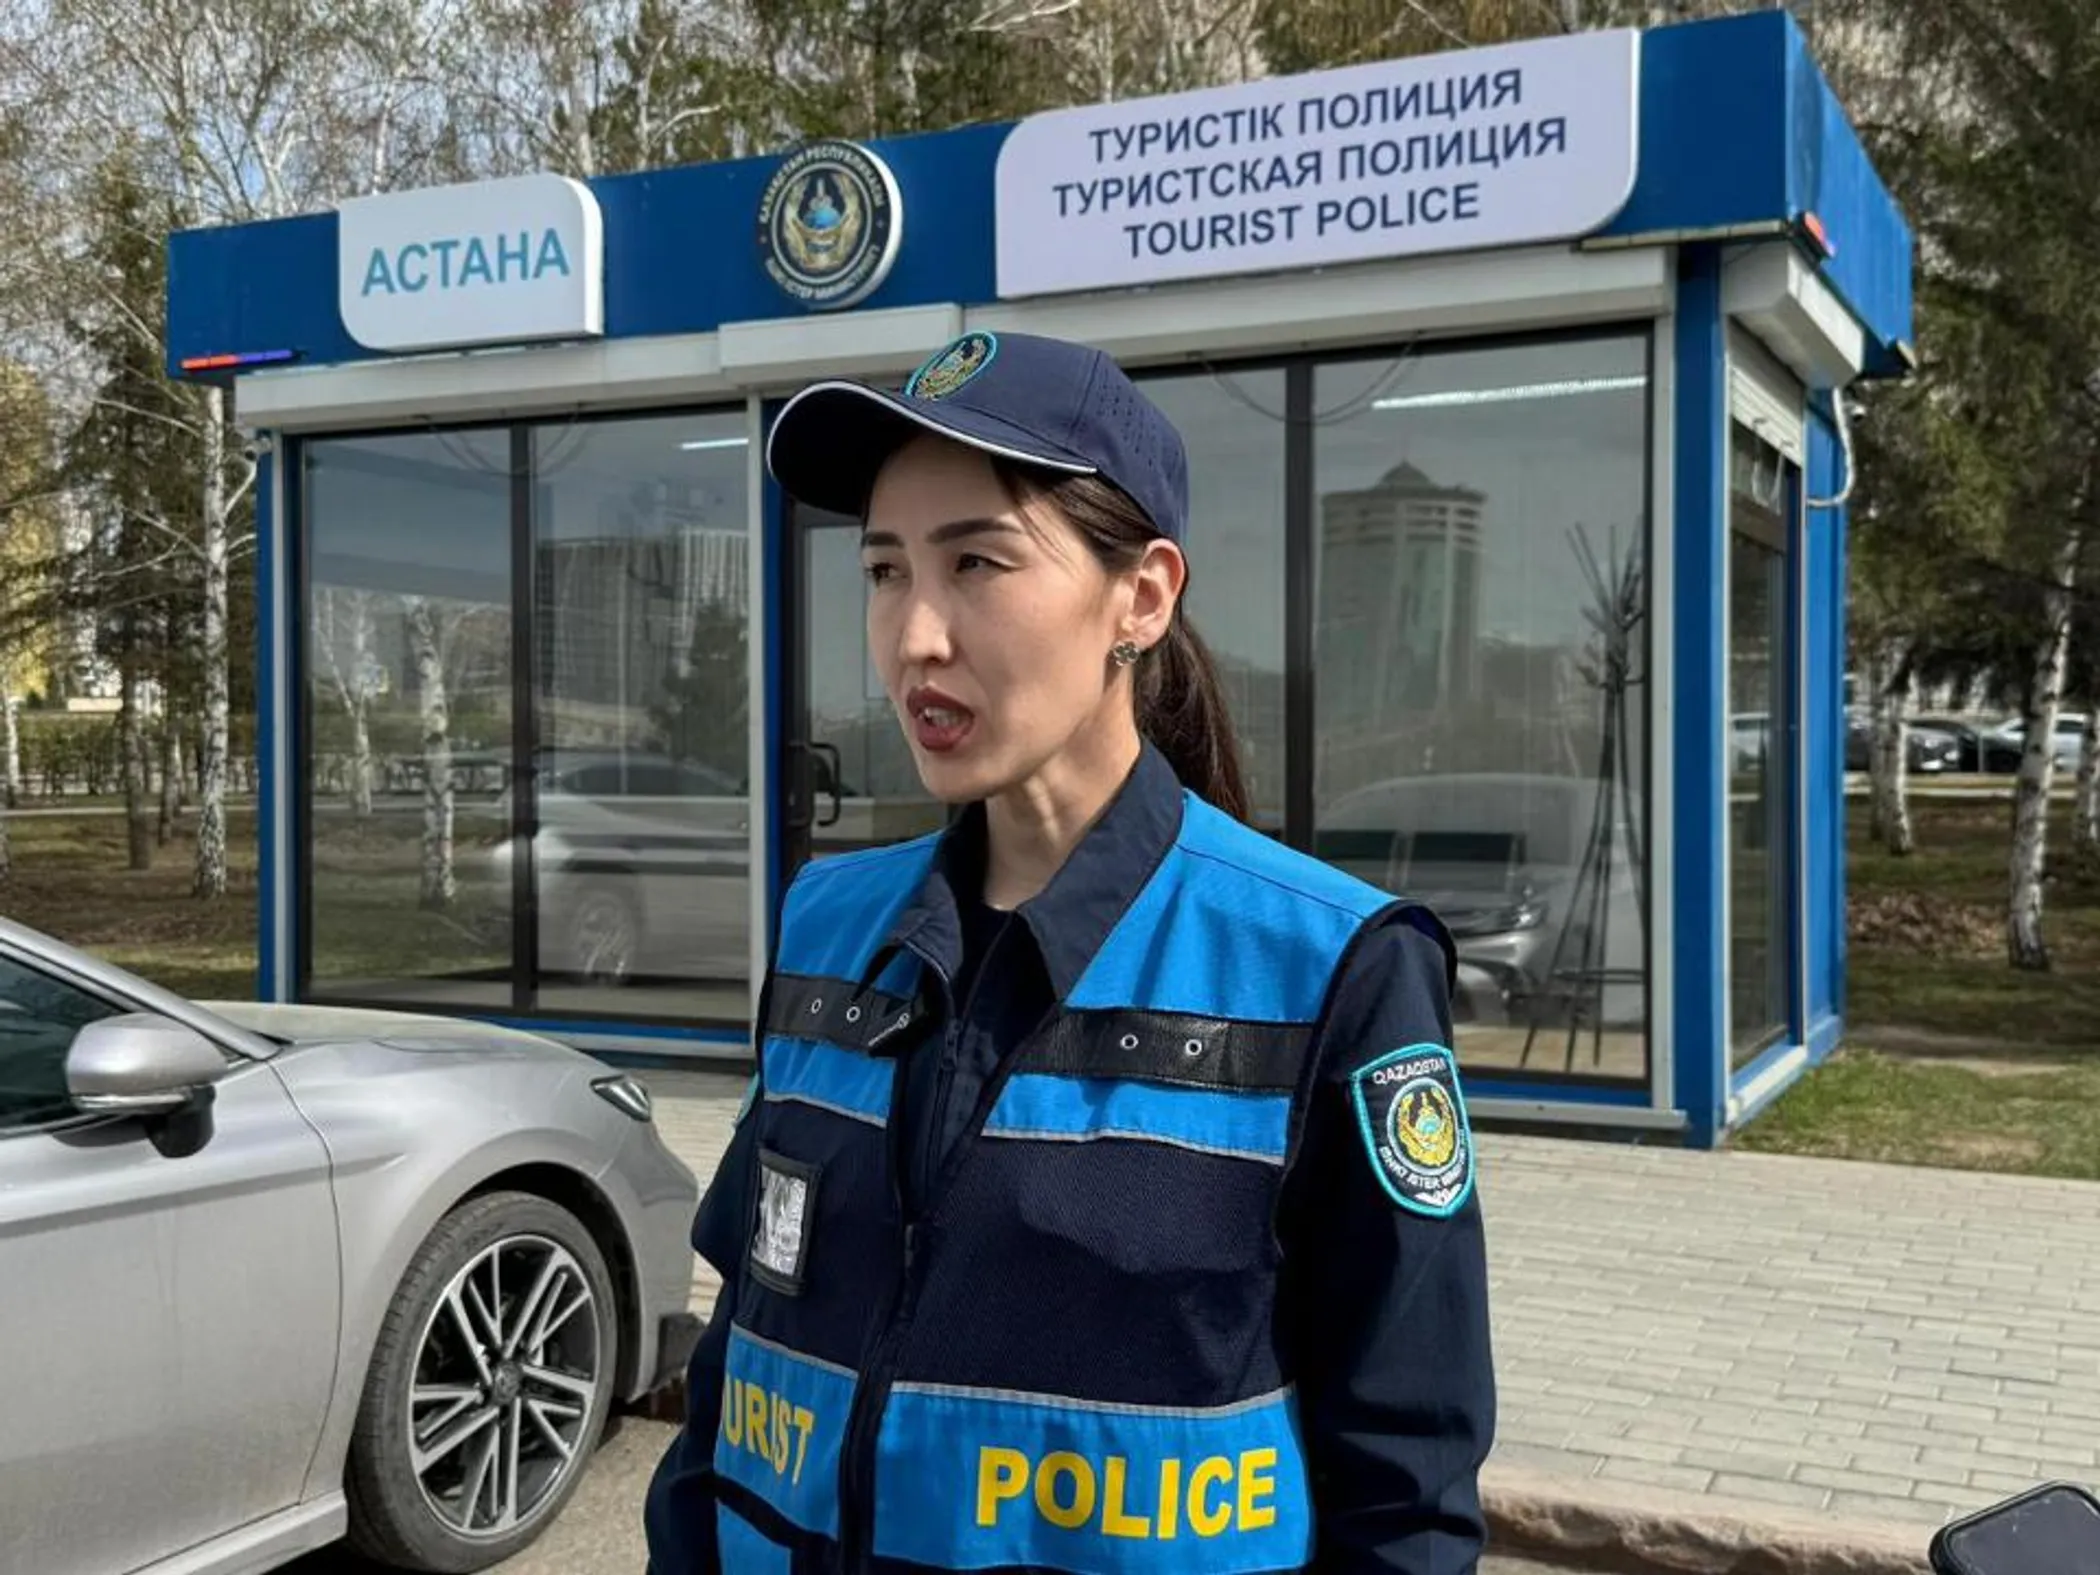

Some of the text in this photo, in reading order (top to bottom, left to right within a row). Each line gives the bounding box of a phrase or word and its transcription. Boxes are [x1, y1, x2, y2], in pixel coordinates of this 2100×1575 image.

[1089, 68, 1521, 163] ТУРИСТІК ПОЛИЦИЯ
[1052, 117, 1566, 217] ТУРИСТСКАЯ ПОЛИЦИЯ
[361, 227, 571, 297] АСТАНА
[1123, 182, 1479, 259] TOURIST POLICE
[976, 1446, 1278, 1540] POLICE
